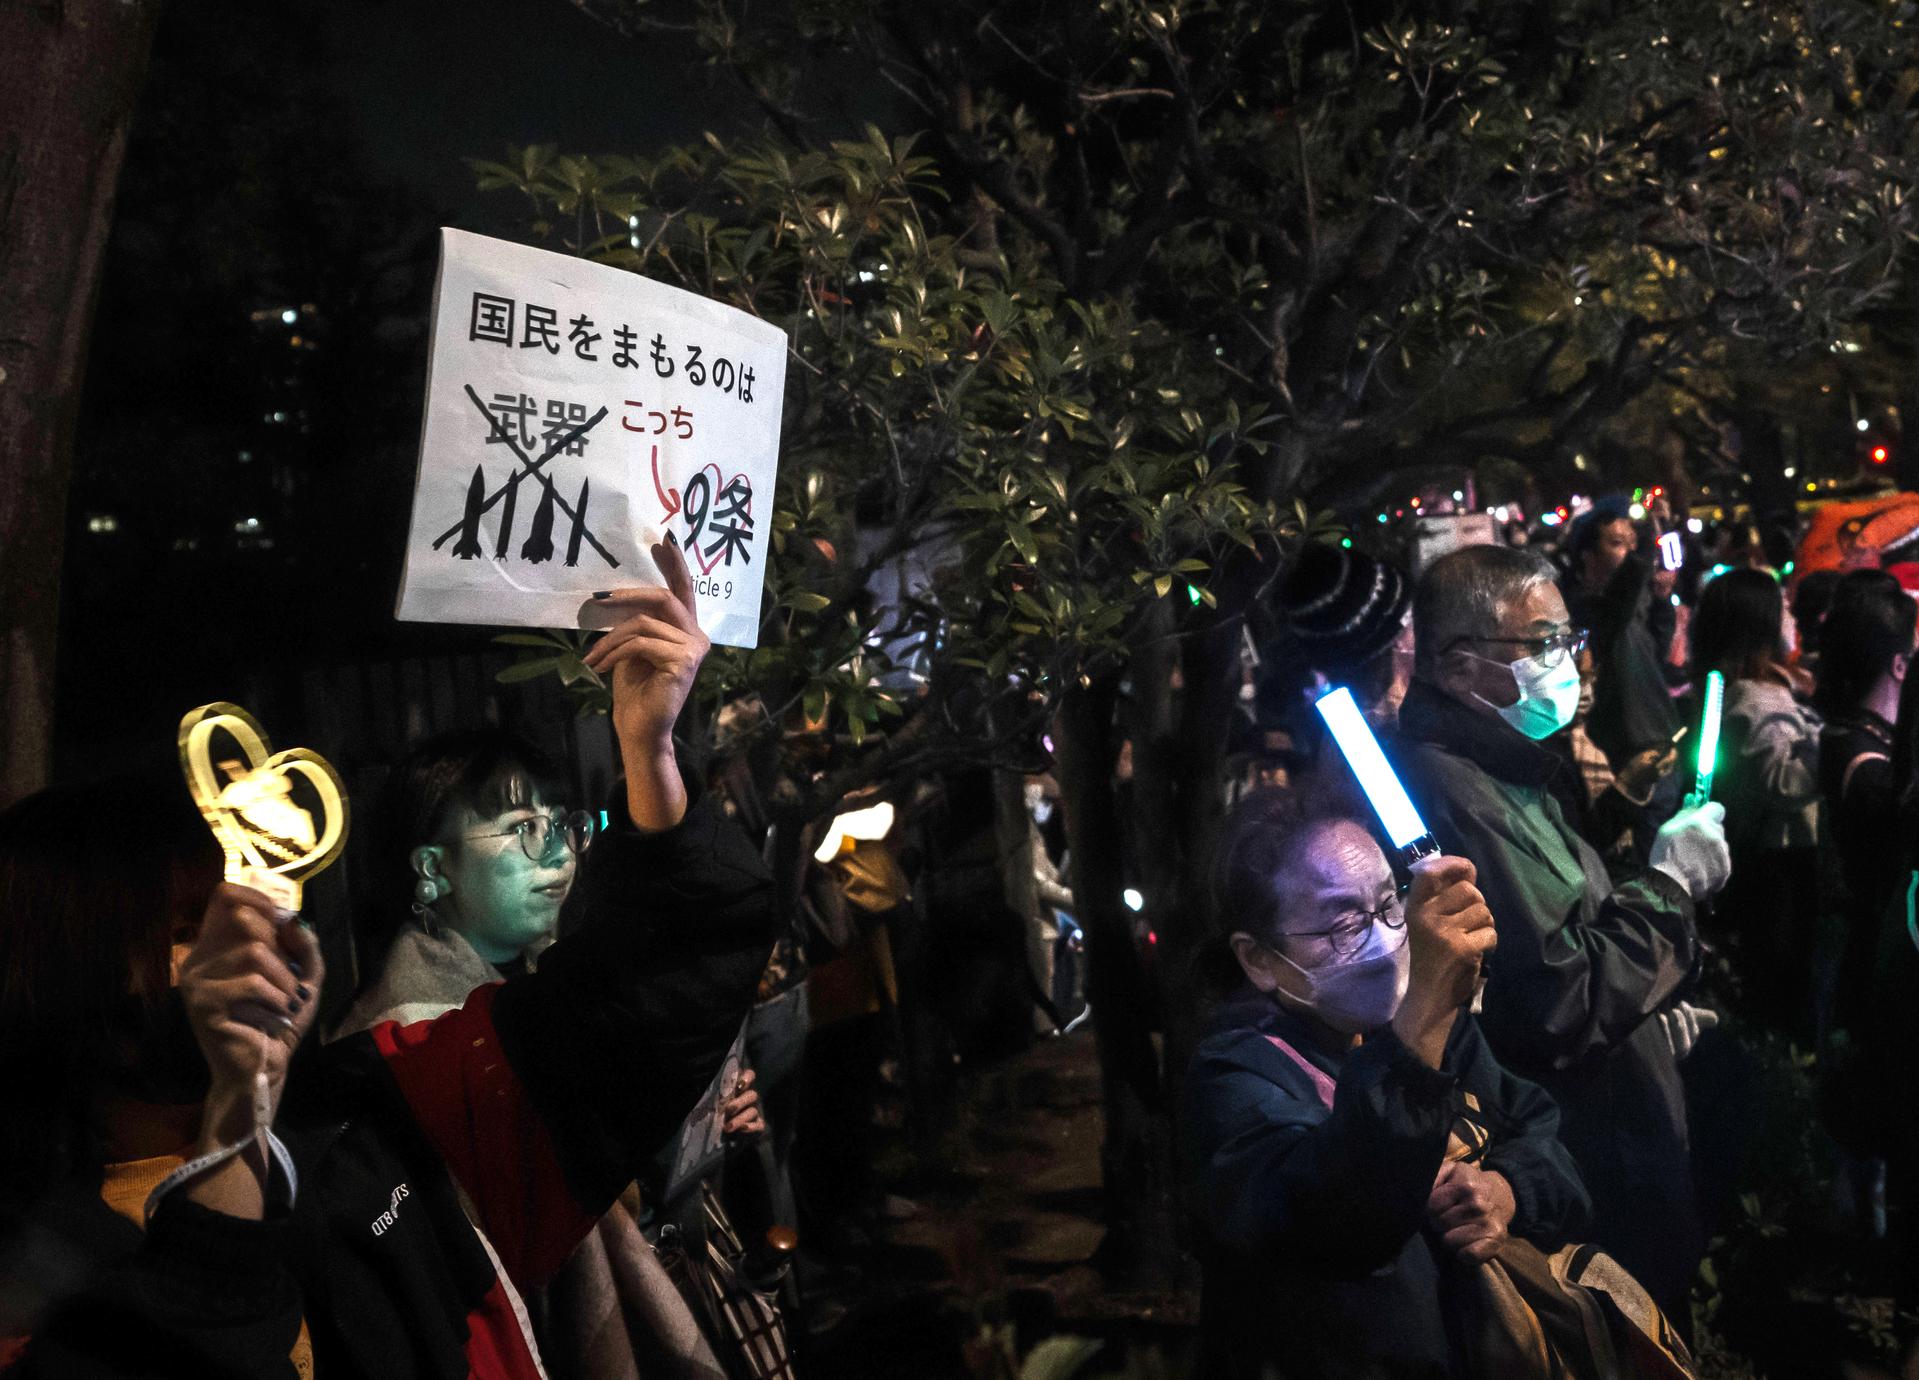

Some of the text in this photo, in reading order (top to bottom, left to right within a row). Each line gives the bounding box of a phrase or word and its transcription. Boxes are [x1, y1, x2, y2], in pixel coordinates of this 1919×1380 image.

[468, 291, 756, 404] 国民をまもるのは
[485, 393, 590, 458] 武器
[621, 400, 694, 439] こっち
[683, 472, 755, 567] 9条
[725, 581, 733, 600] 9
